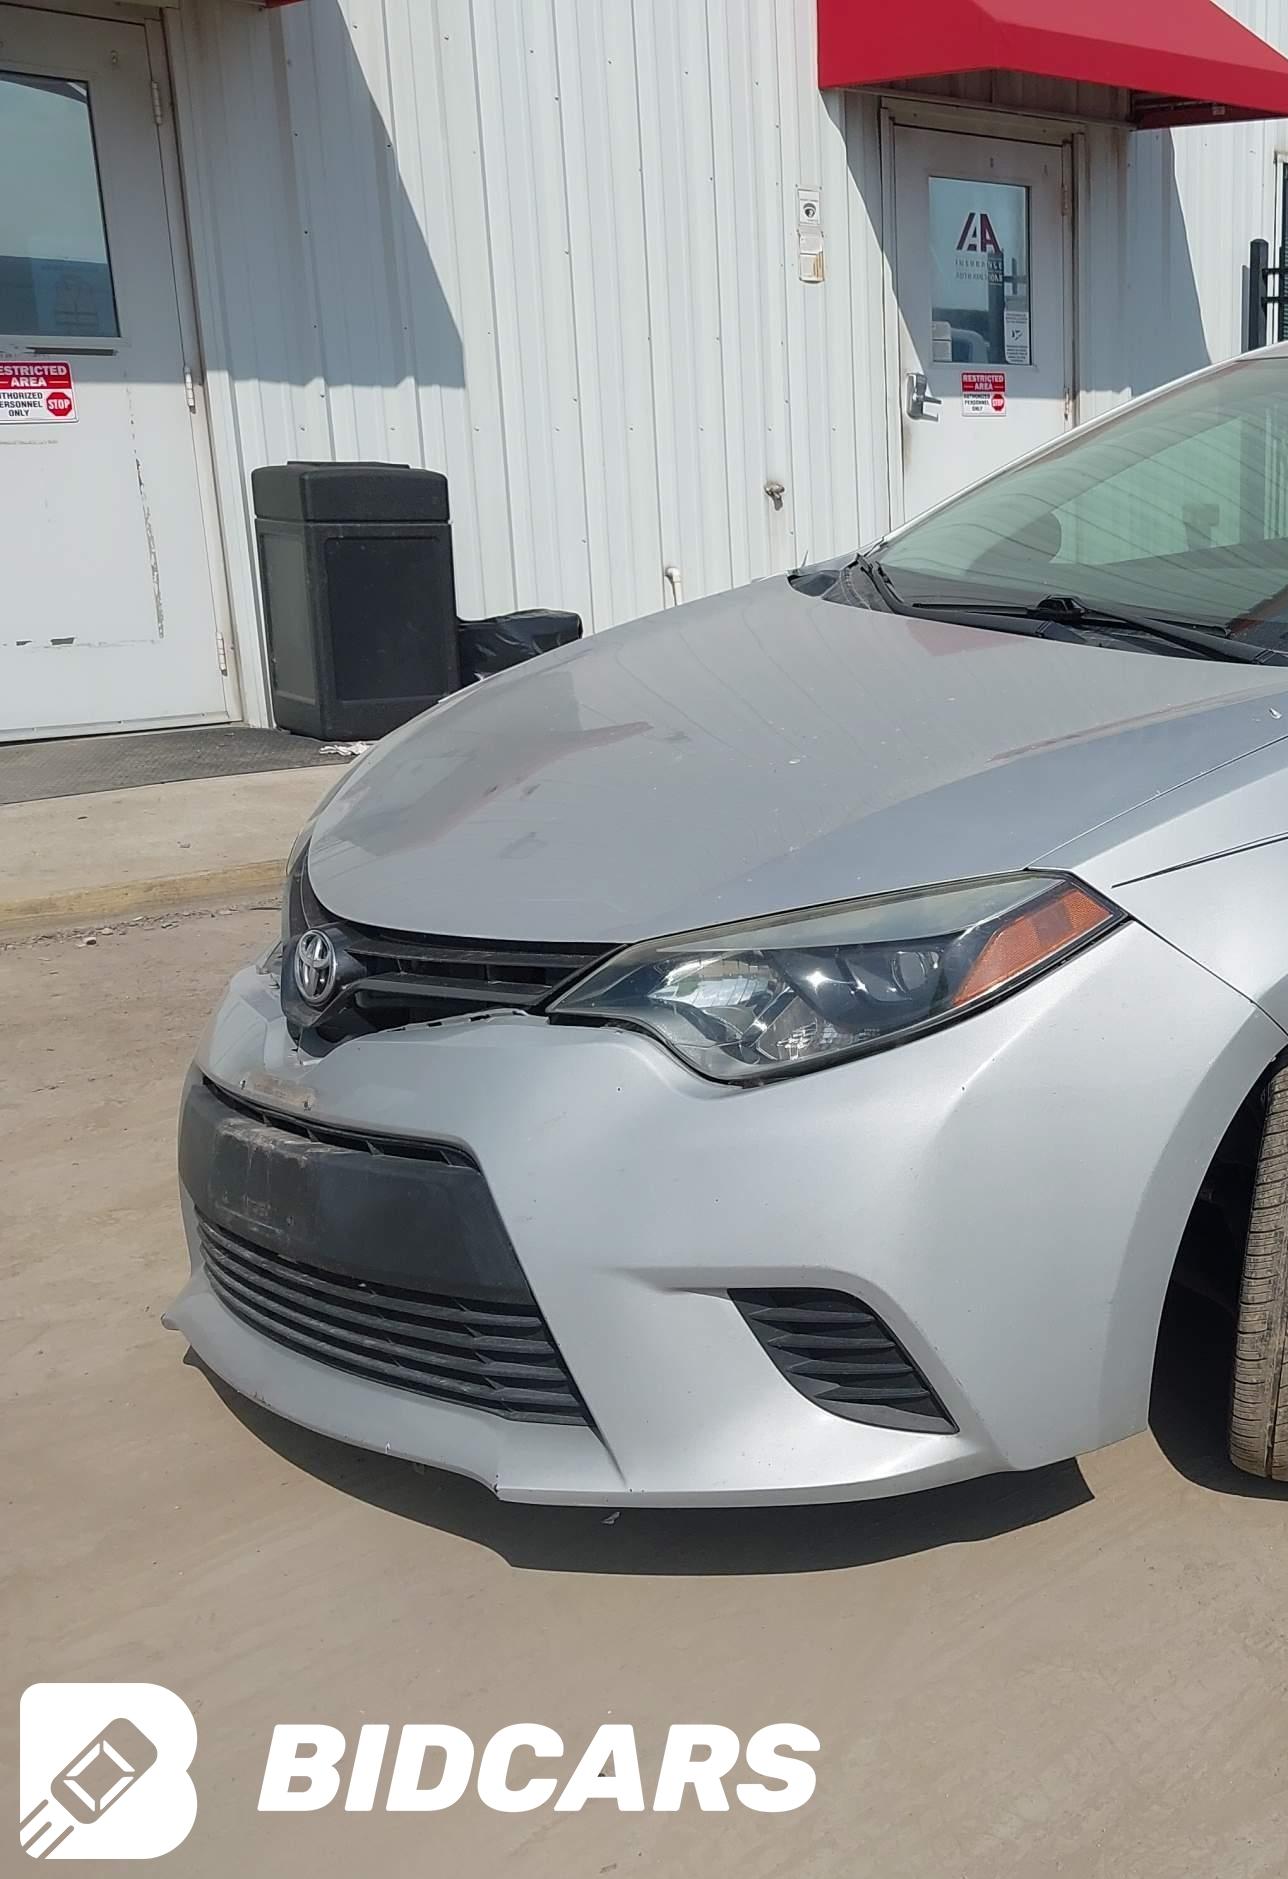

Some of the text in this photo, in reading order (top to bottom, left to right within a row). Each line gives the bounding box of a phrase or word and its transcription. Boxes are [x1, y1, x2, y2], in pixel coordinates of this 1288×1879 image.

[0, 366, 67, 376] ESTRICTED
[10, 377, 47, 387] AREA
[975, 382, 993, 390] AREA
[0, 400, 43, 408] ERSONNEL
[48, 399, 70, 410] STOP
[9, 409, 29, 417] ONLY
